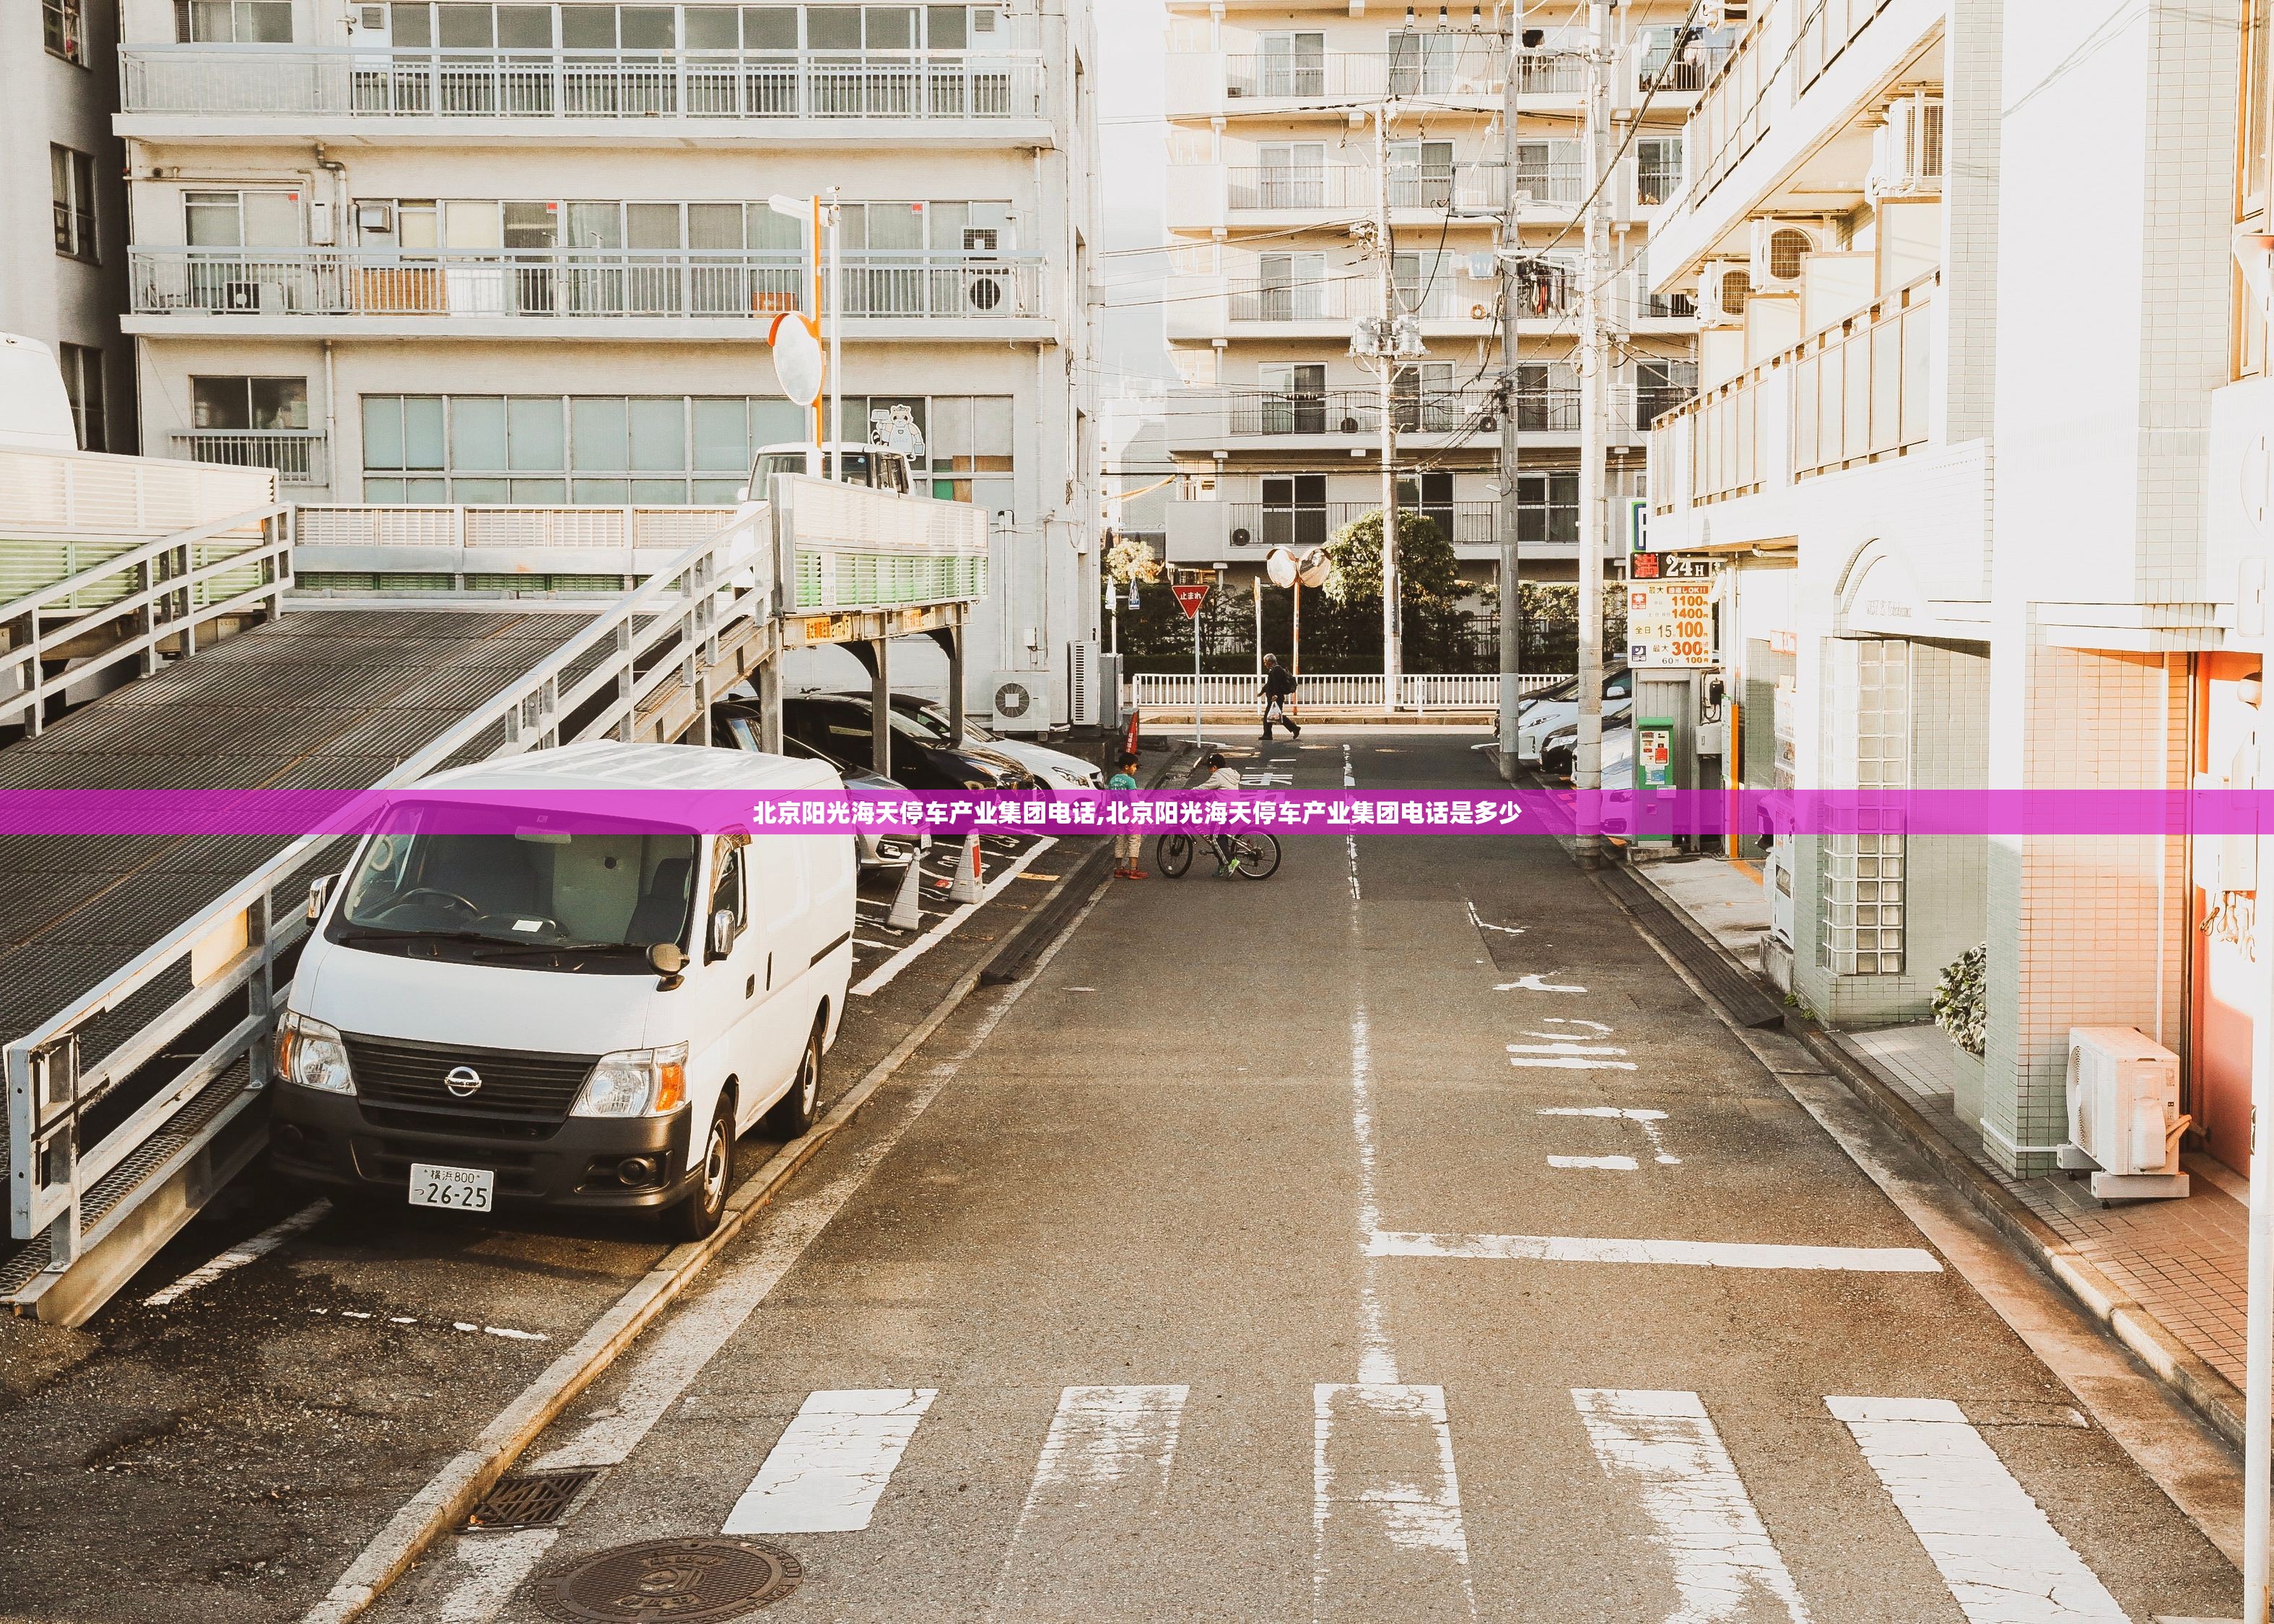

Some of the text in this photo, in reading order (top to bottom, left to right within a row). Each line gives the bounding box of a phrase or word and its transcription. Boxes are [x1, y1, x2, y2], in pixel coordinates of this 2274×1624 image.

[1180, 592, 1202, 601] 止まれ
[1672, 595, 1709, 606] 1100円
[1672, 608, 1709, 619] 1400円
[1635, 626, 1651, 634] 全日
[427, 1182, 488, 1208] 26-25
